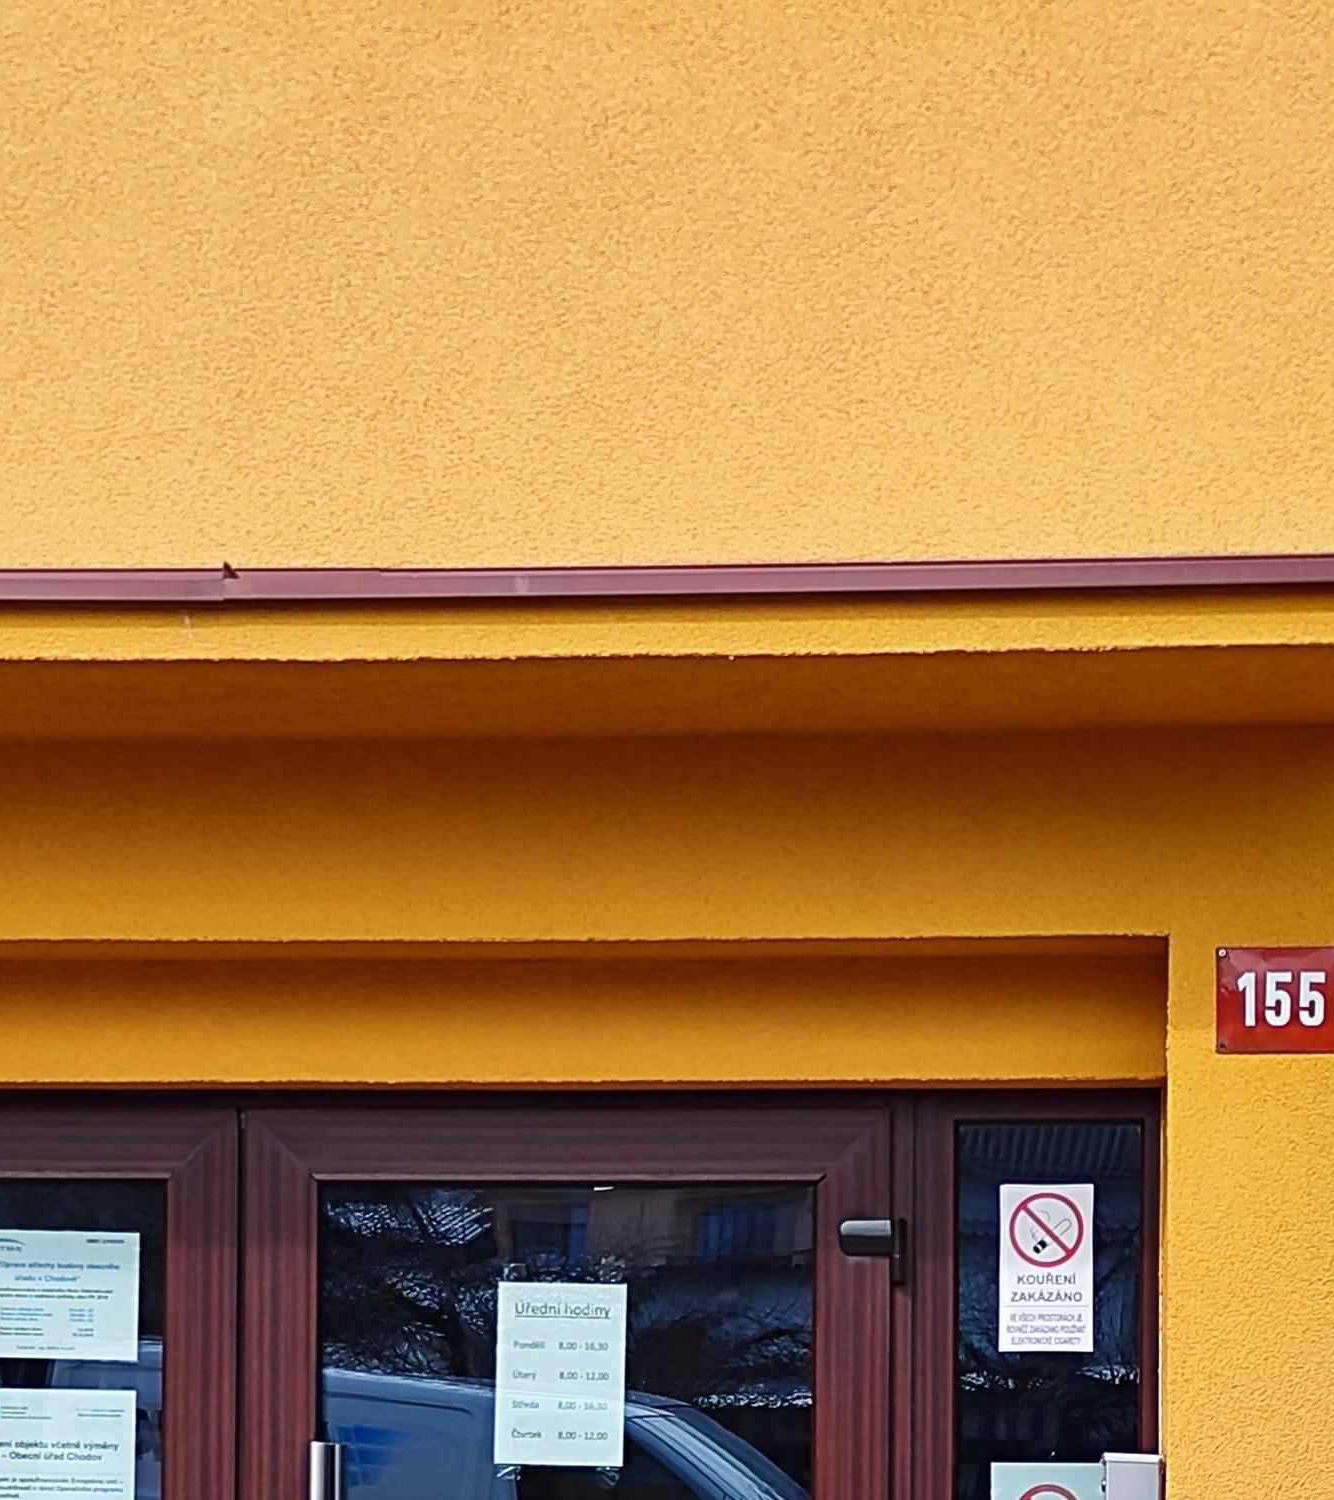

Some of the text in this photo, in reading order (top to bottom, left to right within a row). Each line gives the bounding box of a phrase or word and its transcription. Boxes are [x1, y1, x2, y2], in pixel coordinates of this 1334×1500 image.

[1236, 970, 1327, 1028] 155
[1016, 1272, 1077, 1285] KOUŘENÍ
[1010, 1288, 1083, 1302] ZAKÁZÁNO
[514, 1299, 612, 1318] Úřední hodiny
[513, 1340, 545, 1350] Pondělí
